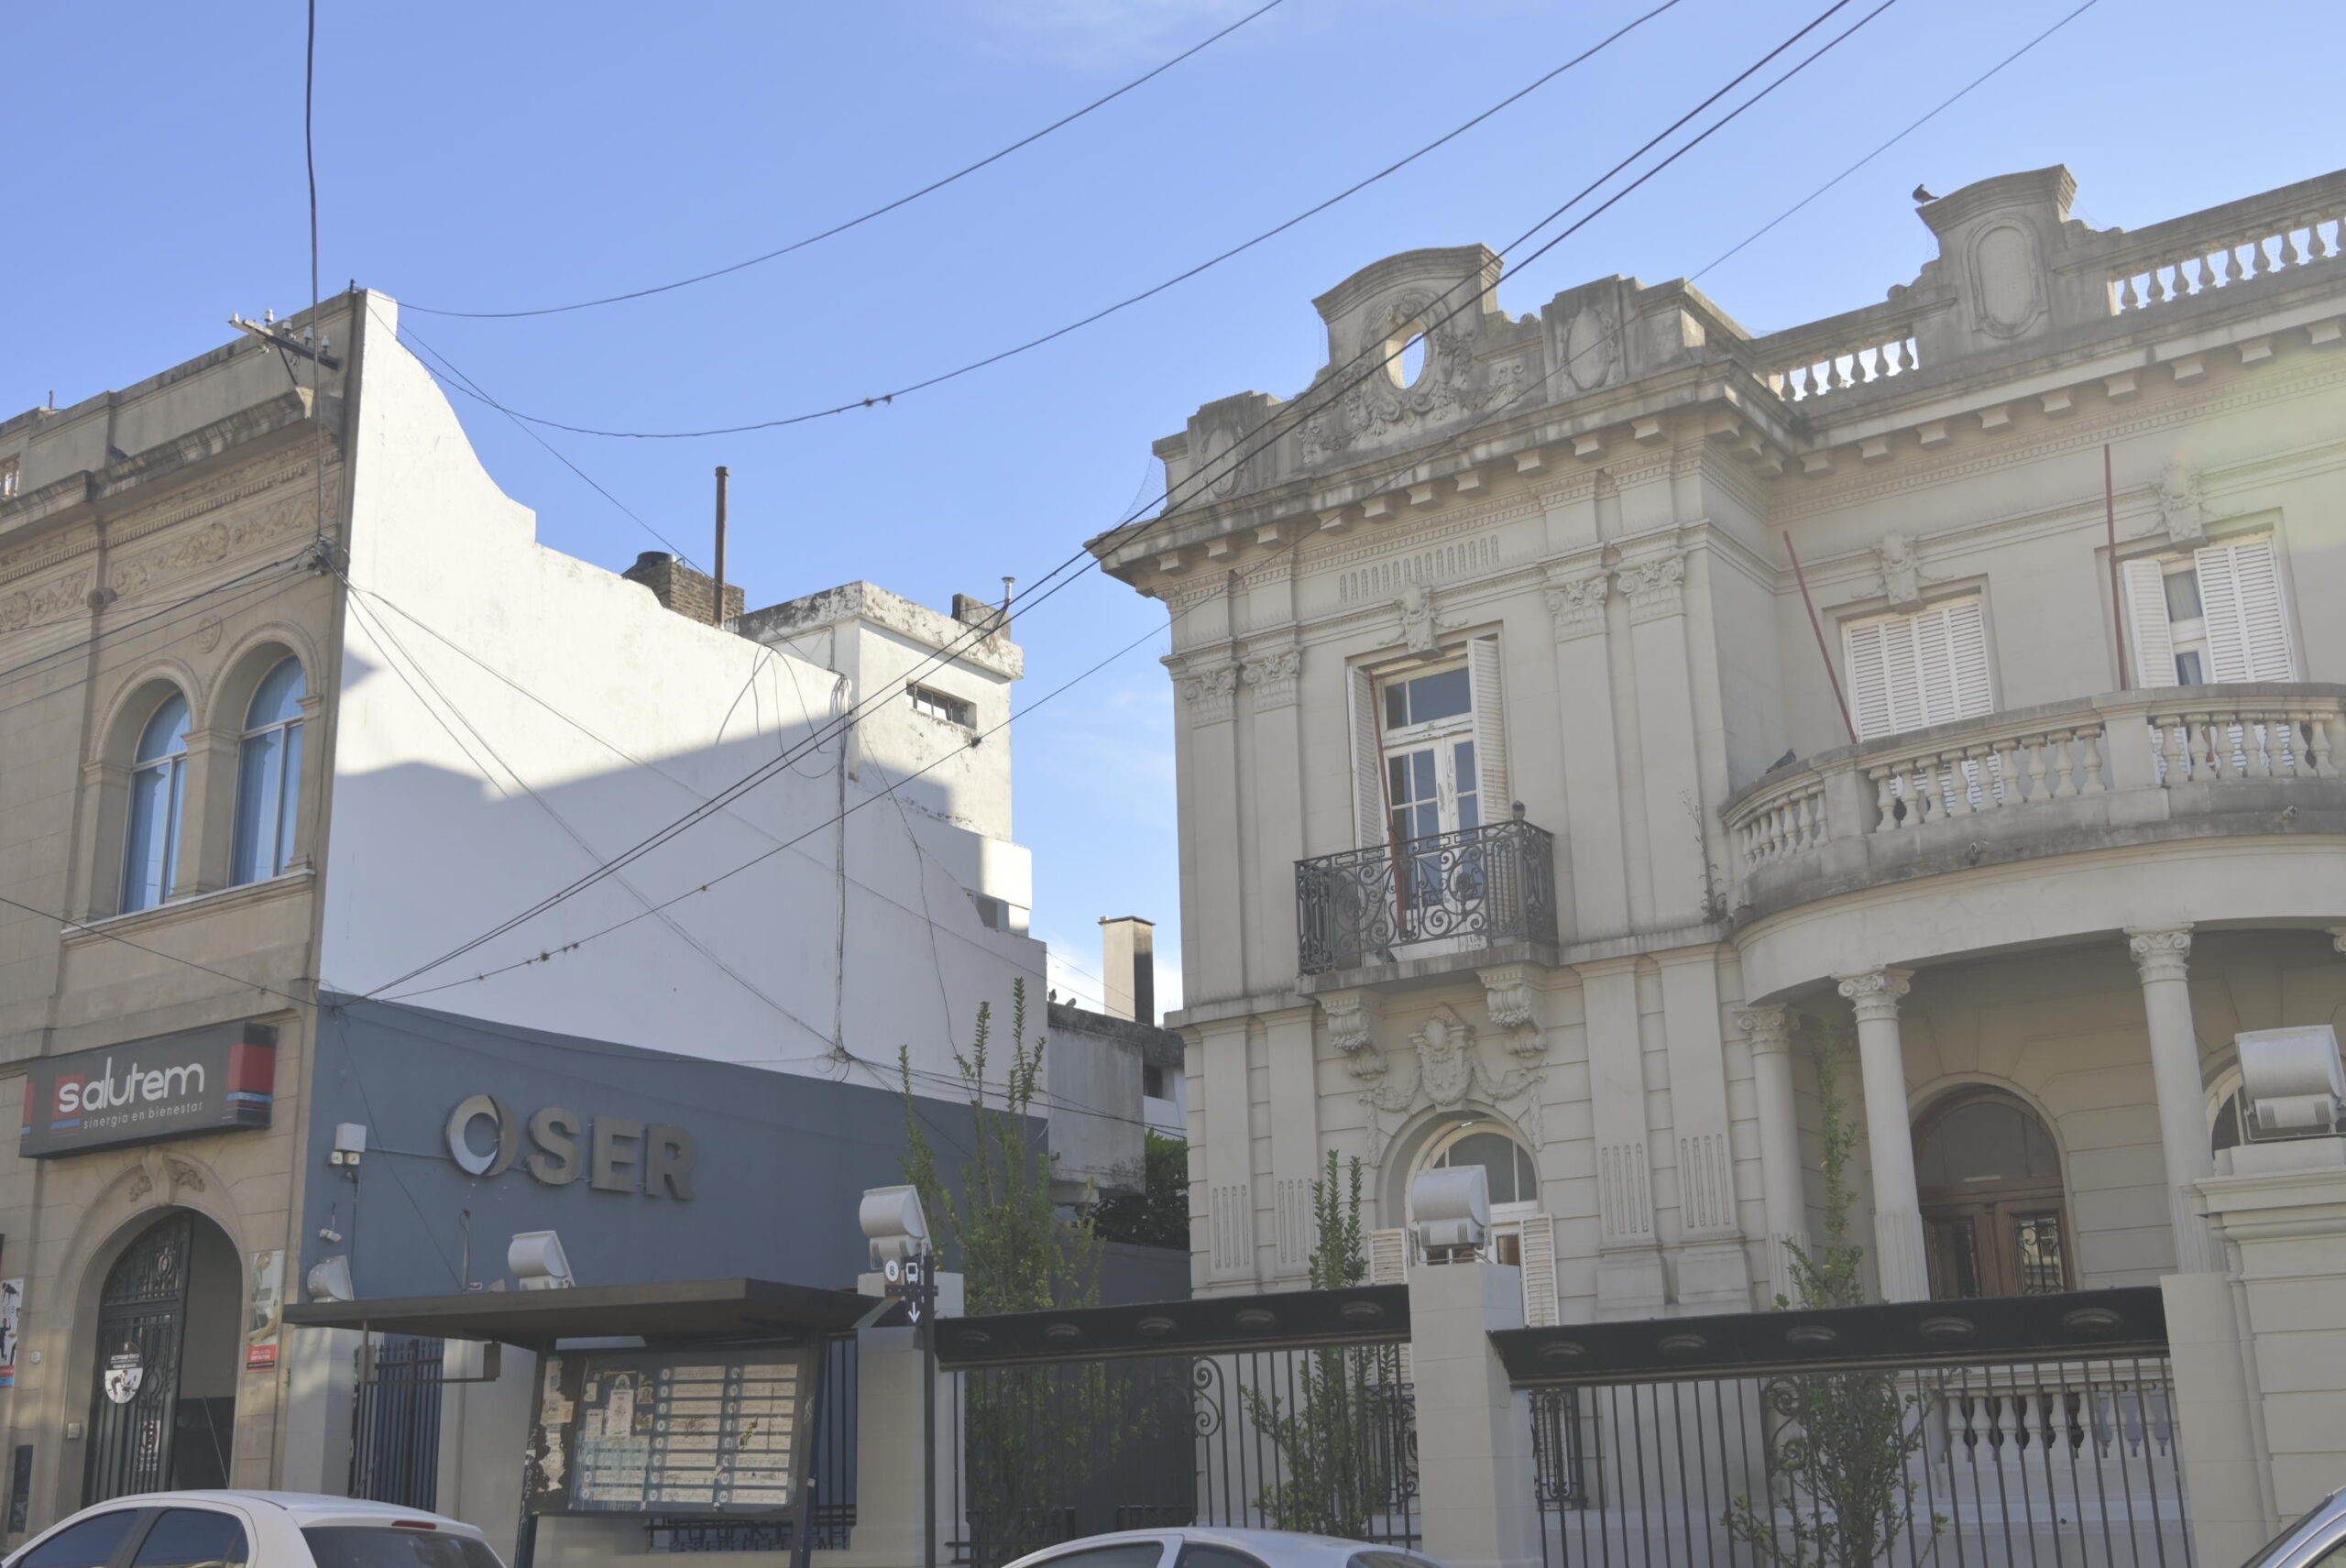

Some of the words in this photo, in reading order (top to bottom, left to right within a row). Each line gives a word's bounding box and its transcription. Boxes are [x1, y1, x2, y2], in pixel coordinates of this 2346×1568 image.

[59, 1057, 205, 1113] salutem
[83, 1112, 128, 1130] sinergia
[132, 1110, 145, 1122] en
[148, 1101, 203, 1119] bienestar
[445, 1093, 696, 1201] OSER
[889, 1265, 895, 1277] 8
